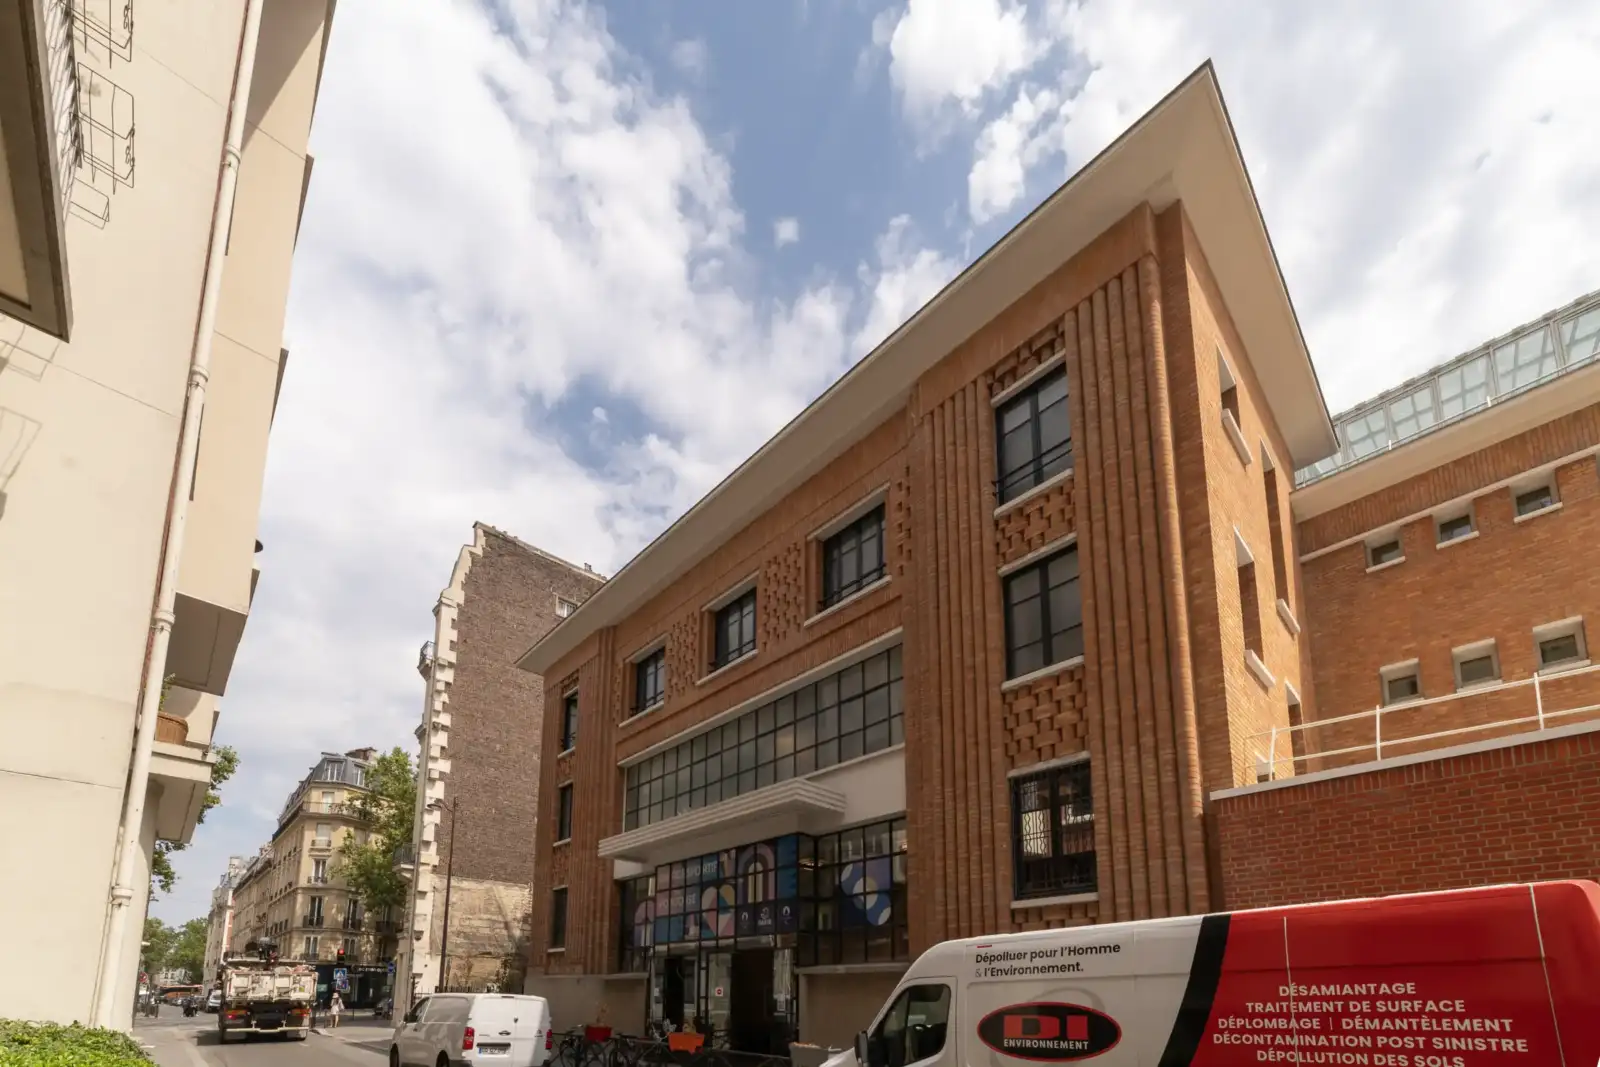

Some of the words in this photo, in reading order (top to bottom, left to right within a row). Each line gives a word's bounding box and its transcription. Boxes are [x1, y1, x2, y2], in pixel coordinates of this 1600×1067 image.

[975, 951, 1028, 965] Dépolluer
[1030, 949, 1058, 962] pour
[1060, 944, 1121, 957] l'Homme
[984, 961, 1084, 977] l'Environnement.
[1279, 982, 1416, 997] DÉSAMIANTAGE
[1246, 1001, 1344, 1013] TRAITEMENT
[1349, 1001, 1371, 1013] DE
[1375, 1000, 1466, 1013] SURFACE
[1218, 1014, 1321, 1029] DÉPLOMBAGE
[1341, 1015, 1513, 1032] DÉMANTÈLEMENT
[1004, 1038, 1089, 1050] ENVIRONNEMENT
[1213, 1031, 1372, 1048] DÉCONTAMINATION
[1376, 1036, 1426, 1049] POST
[1432, 1037, 1529, 1052] SINISTRE
[1257, 1048, 1369, 1065] DÉPOLLUTION
[1373, 1054, 1409, 1066] DES
[1414, 1055, 1465, 1067] SOLS
